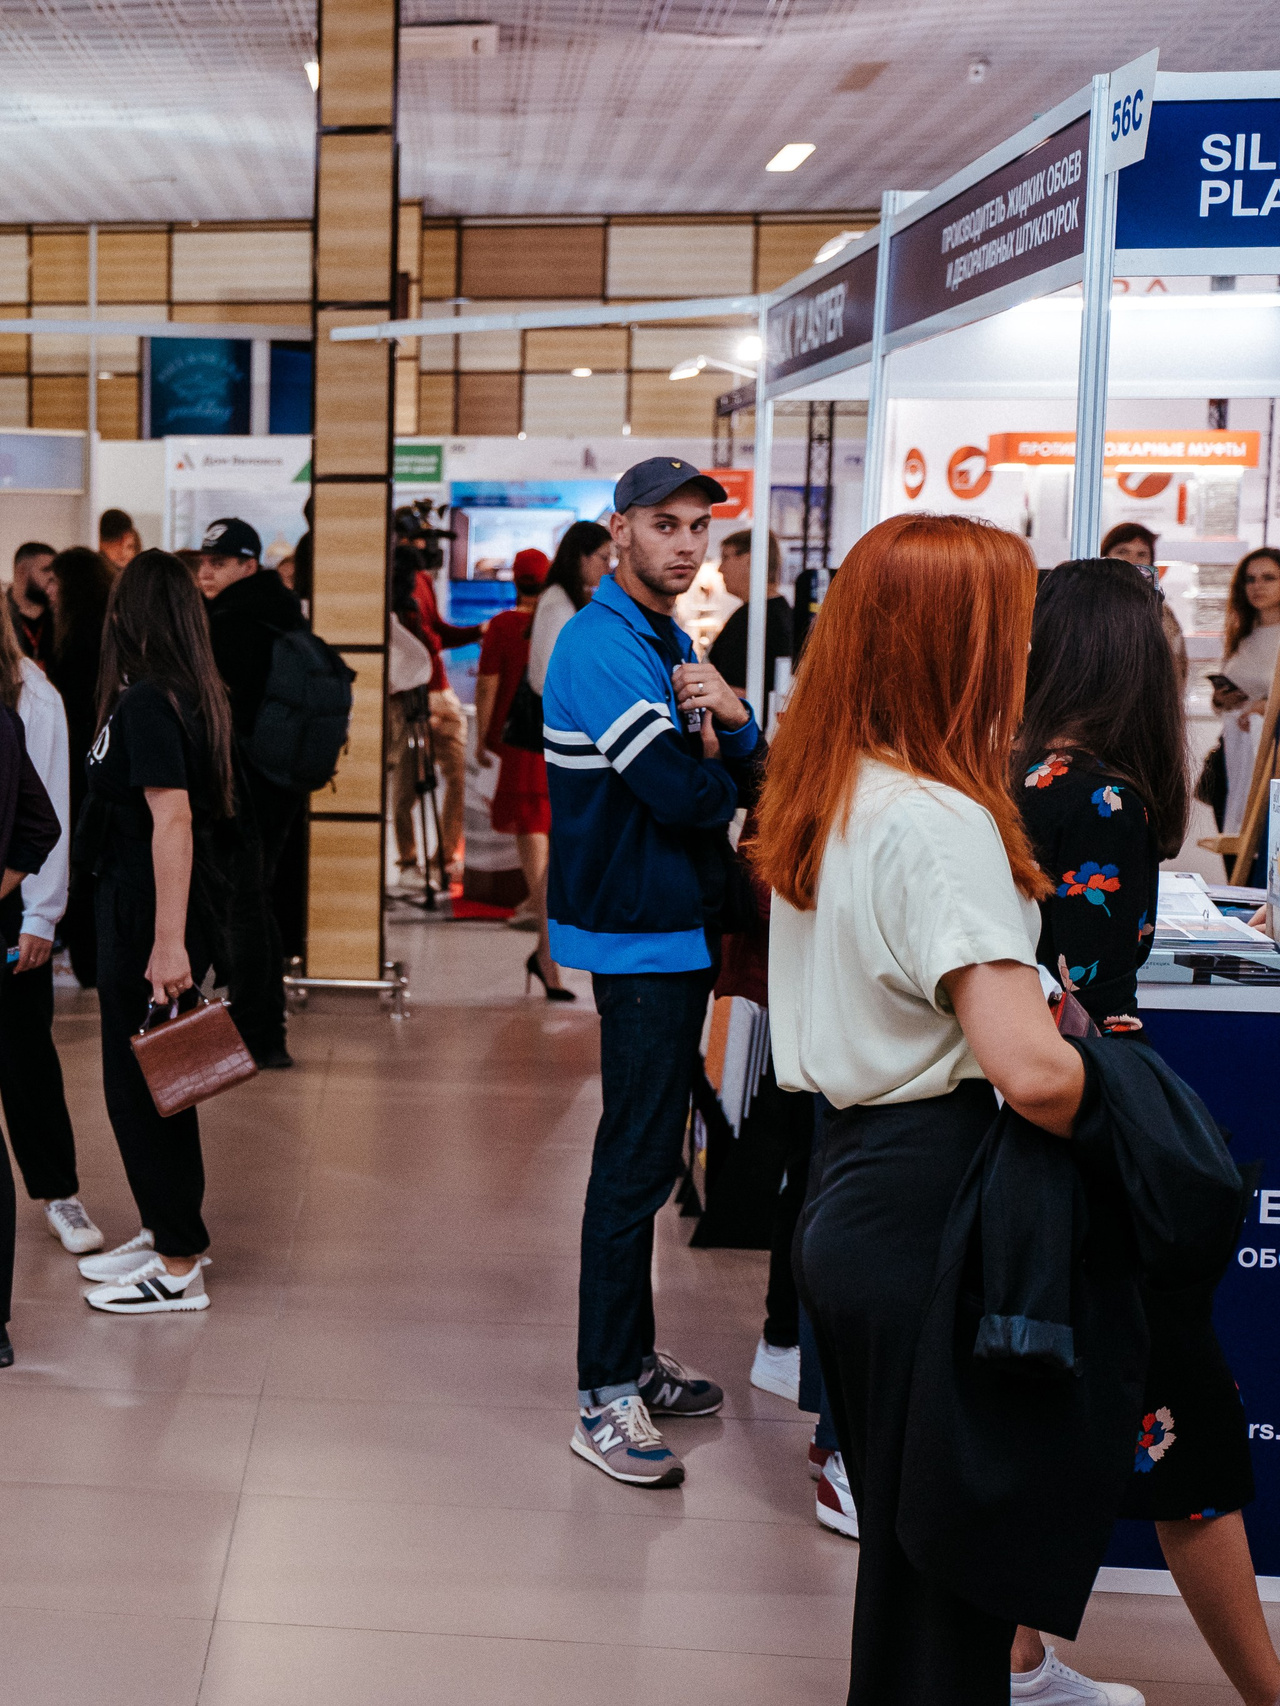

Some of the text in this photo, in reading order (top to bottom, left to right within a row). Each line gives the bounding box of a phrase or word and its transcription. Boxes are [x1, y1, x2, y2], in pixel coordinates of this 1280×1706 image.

[1200, 133, 1280, 172] SIL
[941, 149, 1082, 254] ПРОИЗВОДИТЕЛЬ ЖИДКИХ ОБОЕВ
[950, 229, 1015, 292] ДЕКОРАТИВНЫХ
[1015, 196, 1080, 257] ШТУКАТУРОК
[1188, 440, 1247, 459] МУФТЫ
[1237, 1246, 1280, 1269] ОБ
[592, 1423, 624, 1453] N
